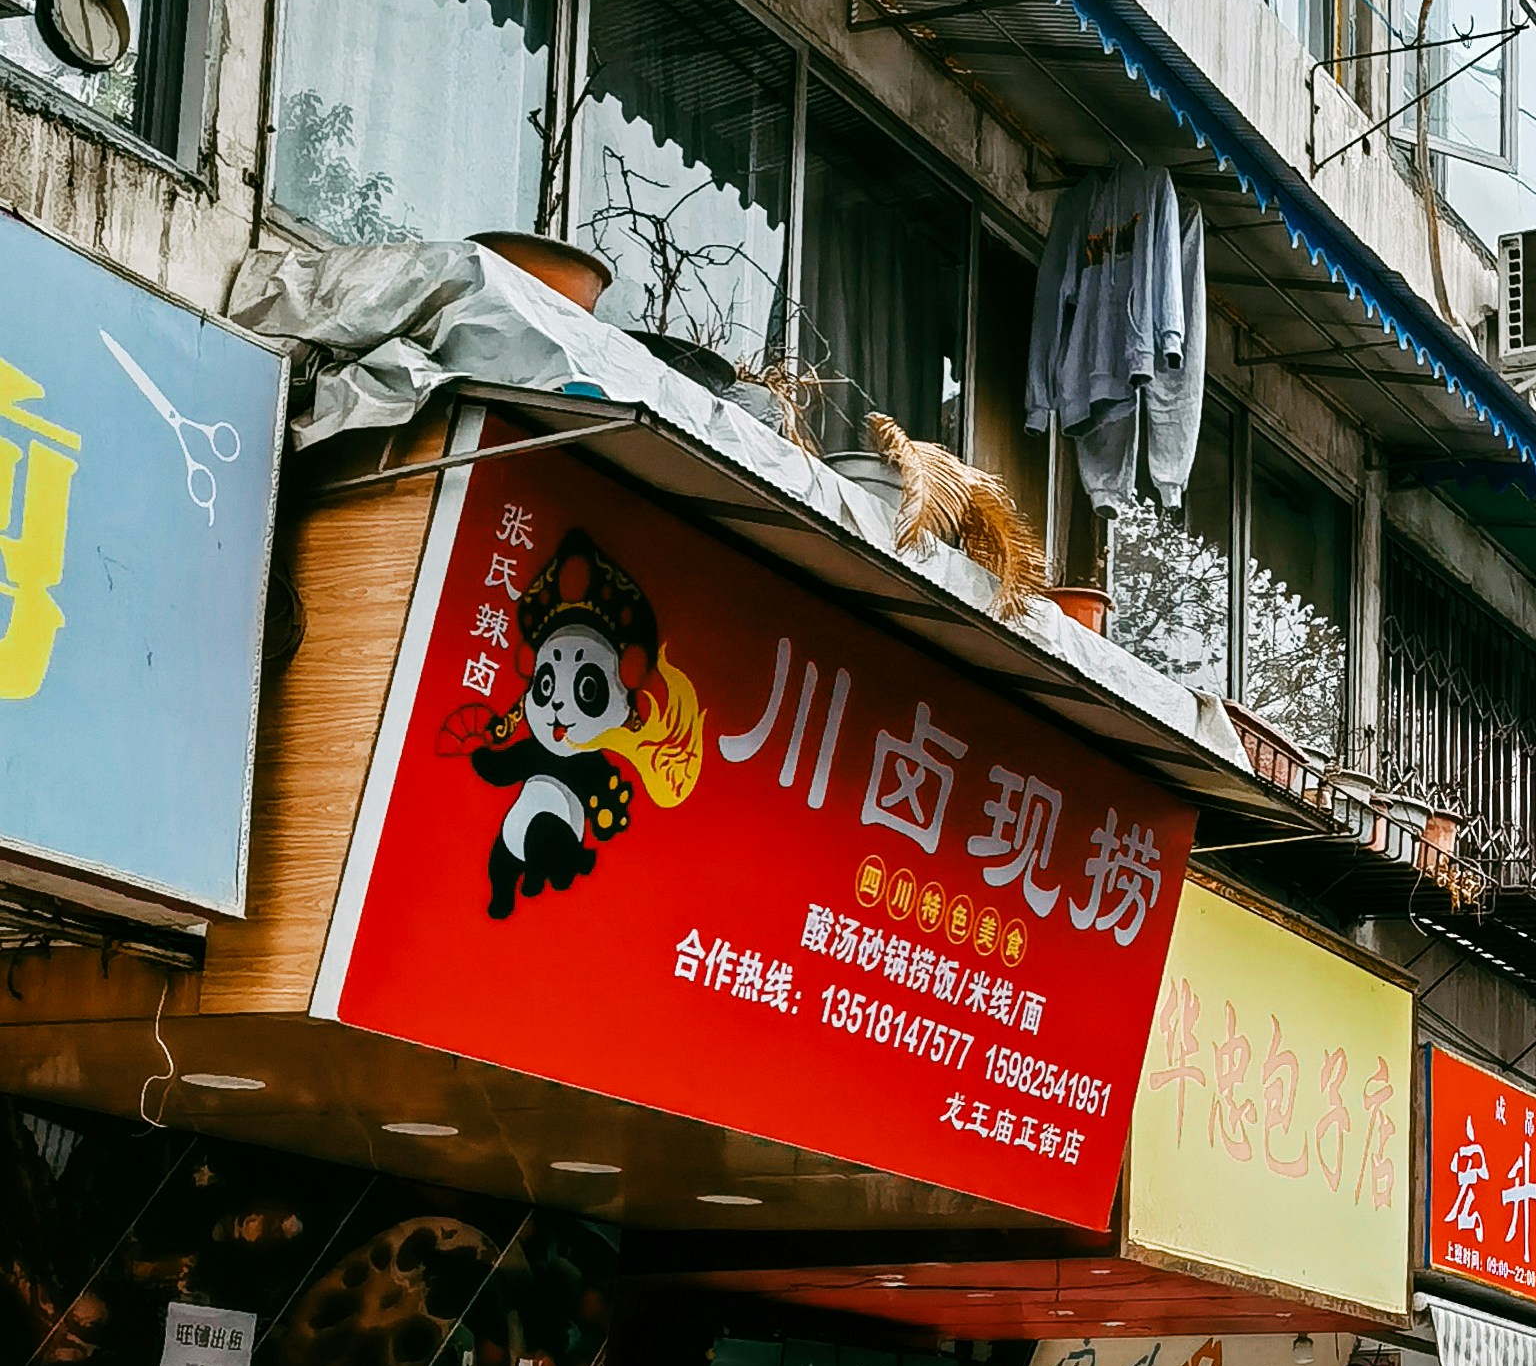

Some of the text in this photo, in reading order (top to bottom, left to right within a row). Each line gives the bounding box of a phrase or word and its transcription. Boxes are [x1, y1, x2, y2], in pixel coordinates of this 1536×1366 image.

[460, 502, 534, 697] 张氏辣卤
[718, 637, 1163, 947] 川卤现捞
[859, 863, 1026, 961] 四川特色美食
[820, 983, 975, 1072] 13518147577
[984, 1042, 1112, 1118] 15982541951
[940, 1091, 1086, 1166] 龙王庙正街店
[1149, 976, 1396, 1212] 华忠包子店
